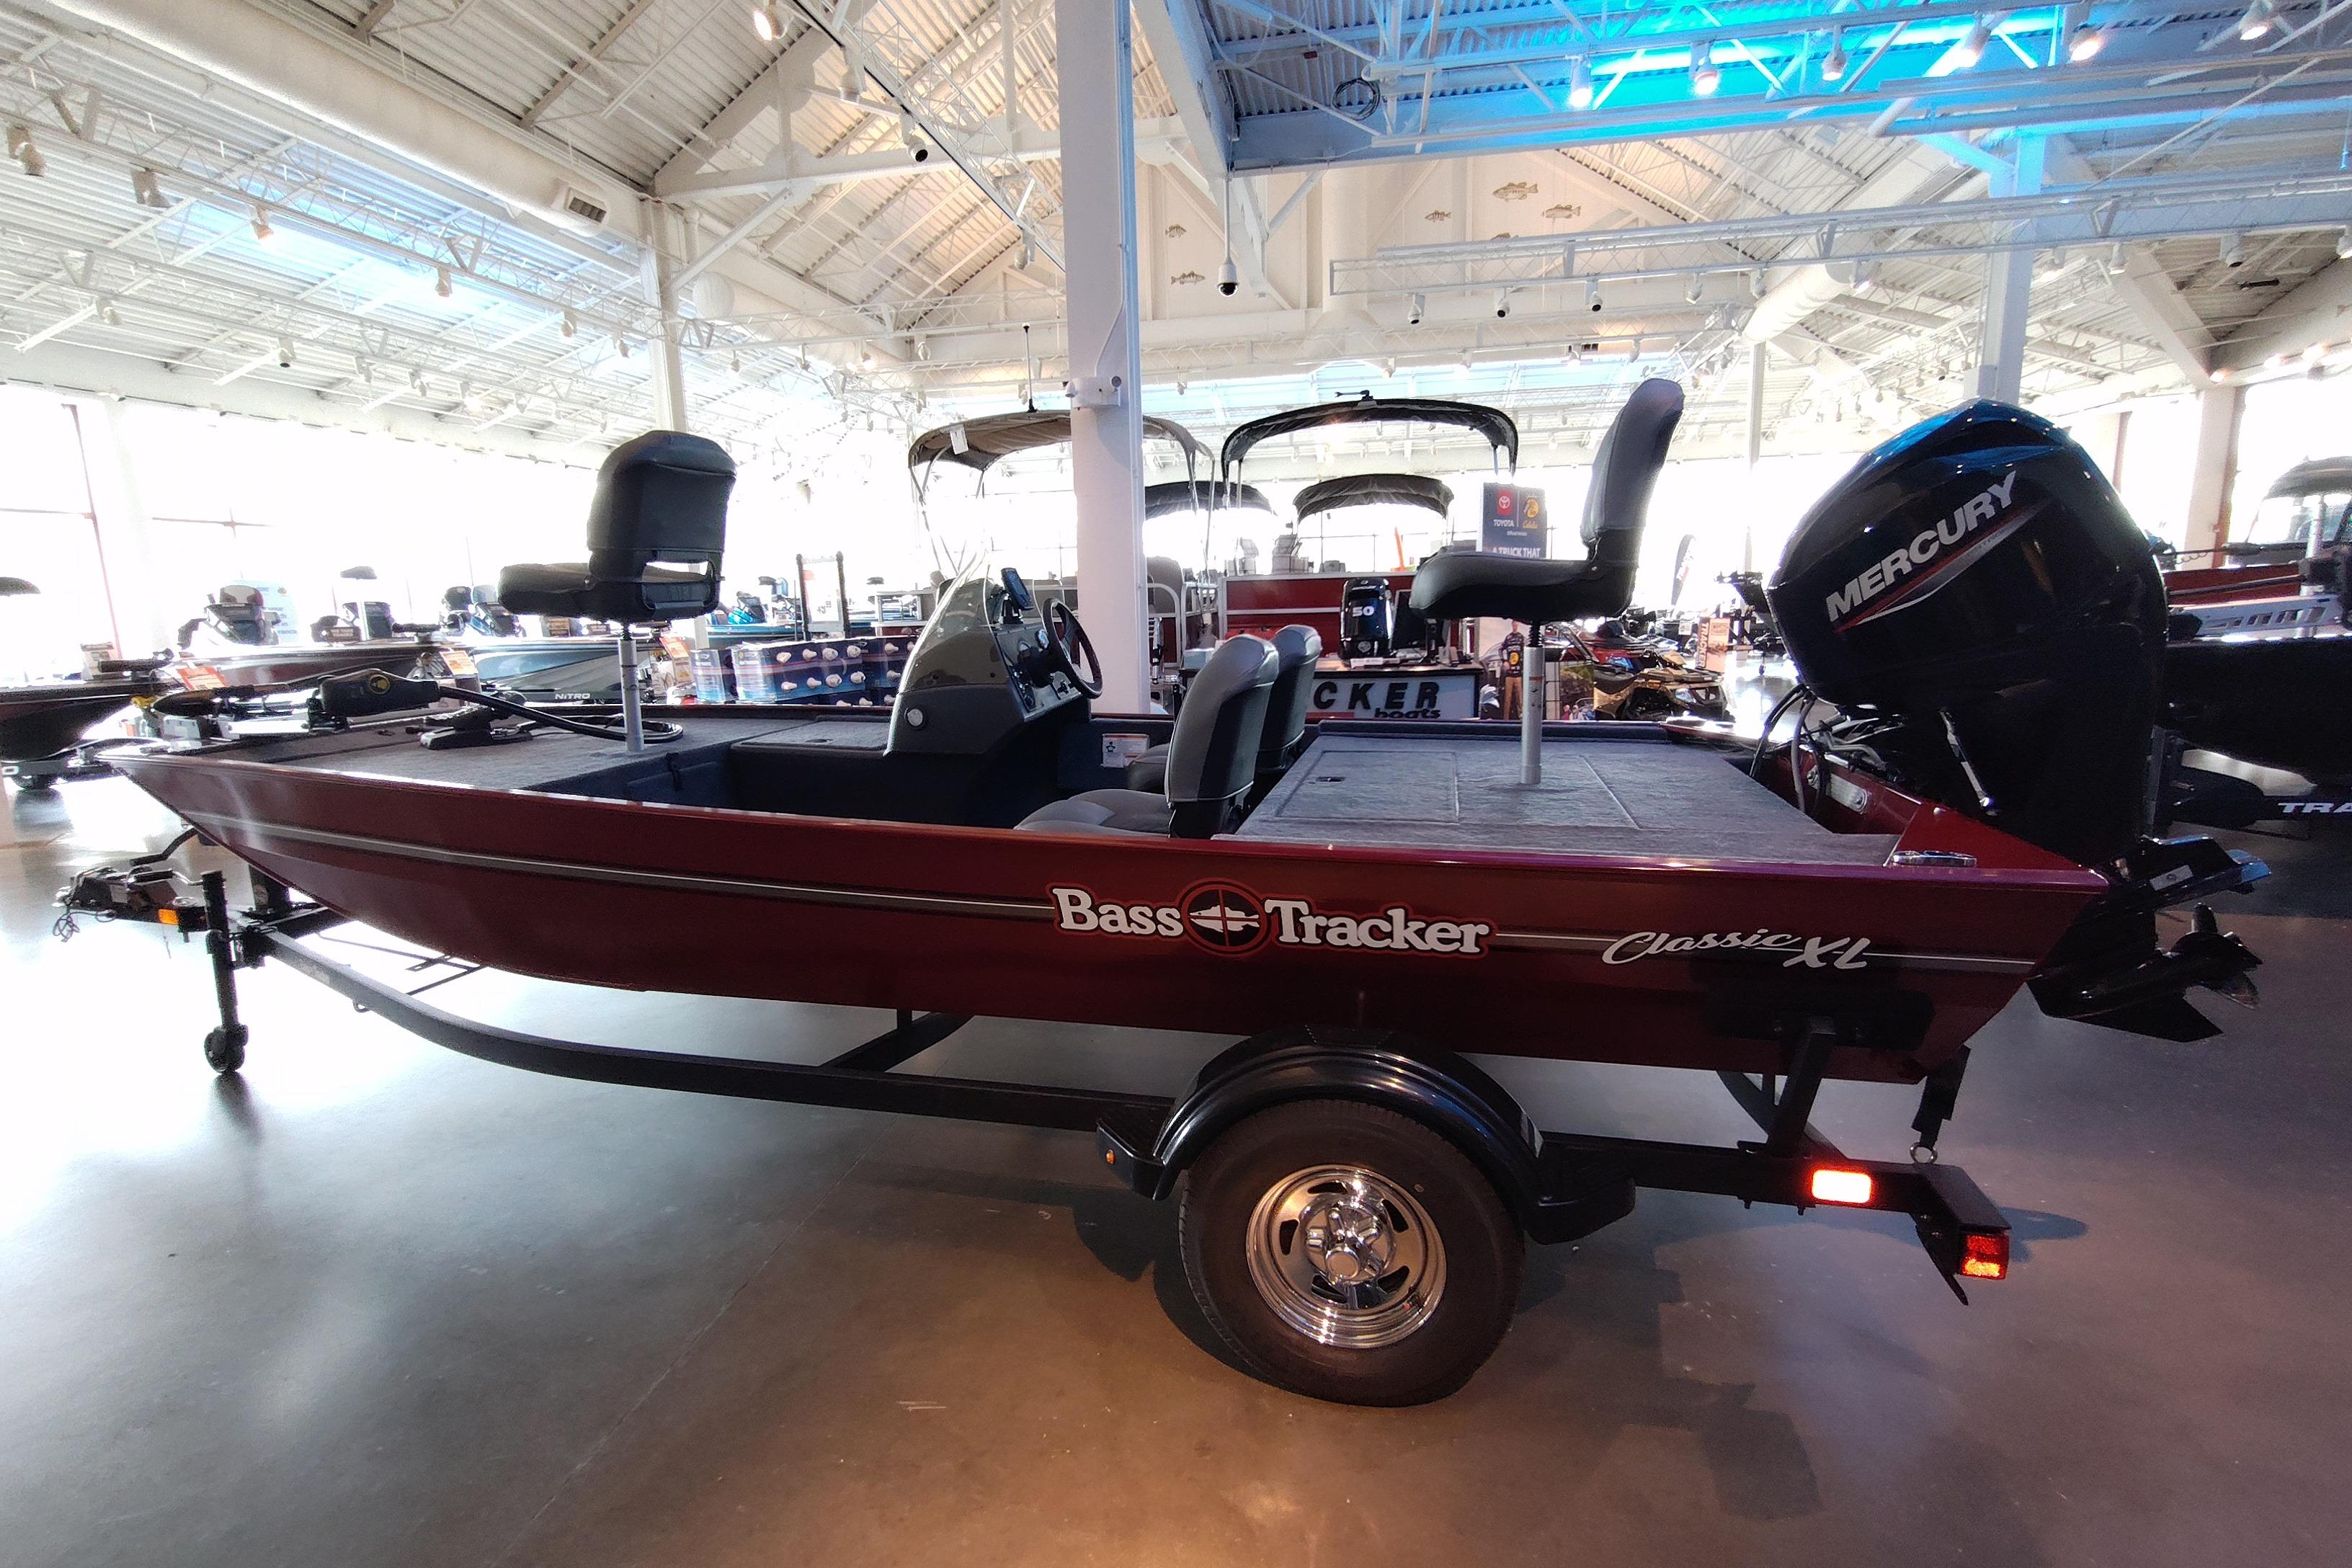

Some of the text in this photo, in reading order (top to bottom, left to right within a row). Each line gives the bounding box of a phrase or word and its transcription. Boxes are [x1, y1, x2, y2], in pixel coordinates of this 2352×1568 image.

[1492, 519, 1515, 527] TOYOTA
[1498, 548, 1523, 557] TRUCK
[1523, 548, 1541, 558] THAT
[1826, 471, 2016, 622] MERCURY
[1353, 606, 1375, 618] 50
[1696, 622, 1709, 668] TRACKER
[1314, 682, 1440, 710] CKER
[1375, 708, 1440, 719] boats
[1053, 888, 1489, 953] Bass Tracker
[1602, 929, 1871, 969] Classic XL
